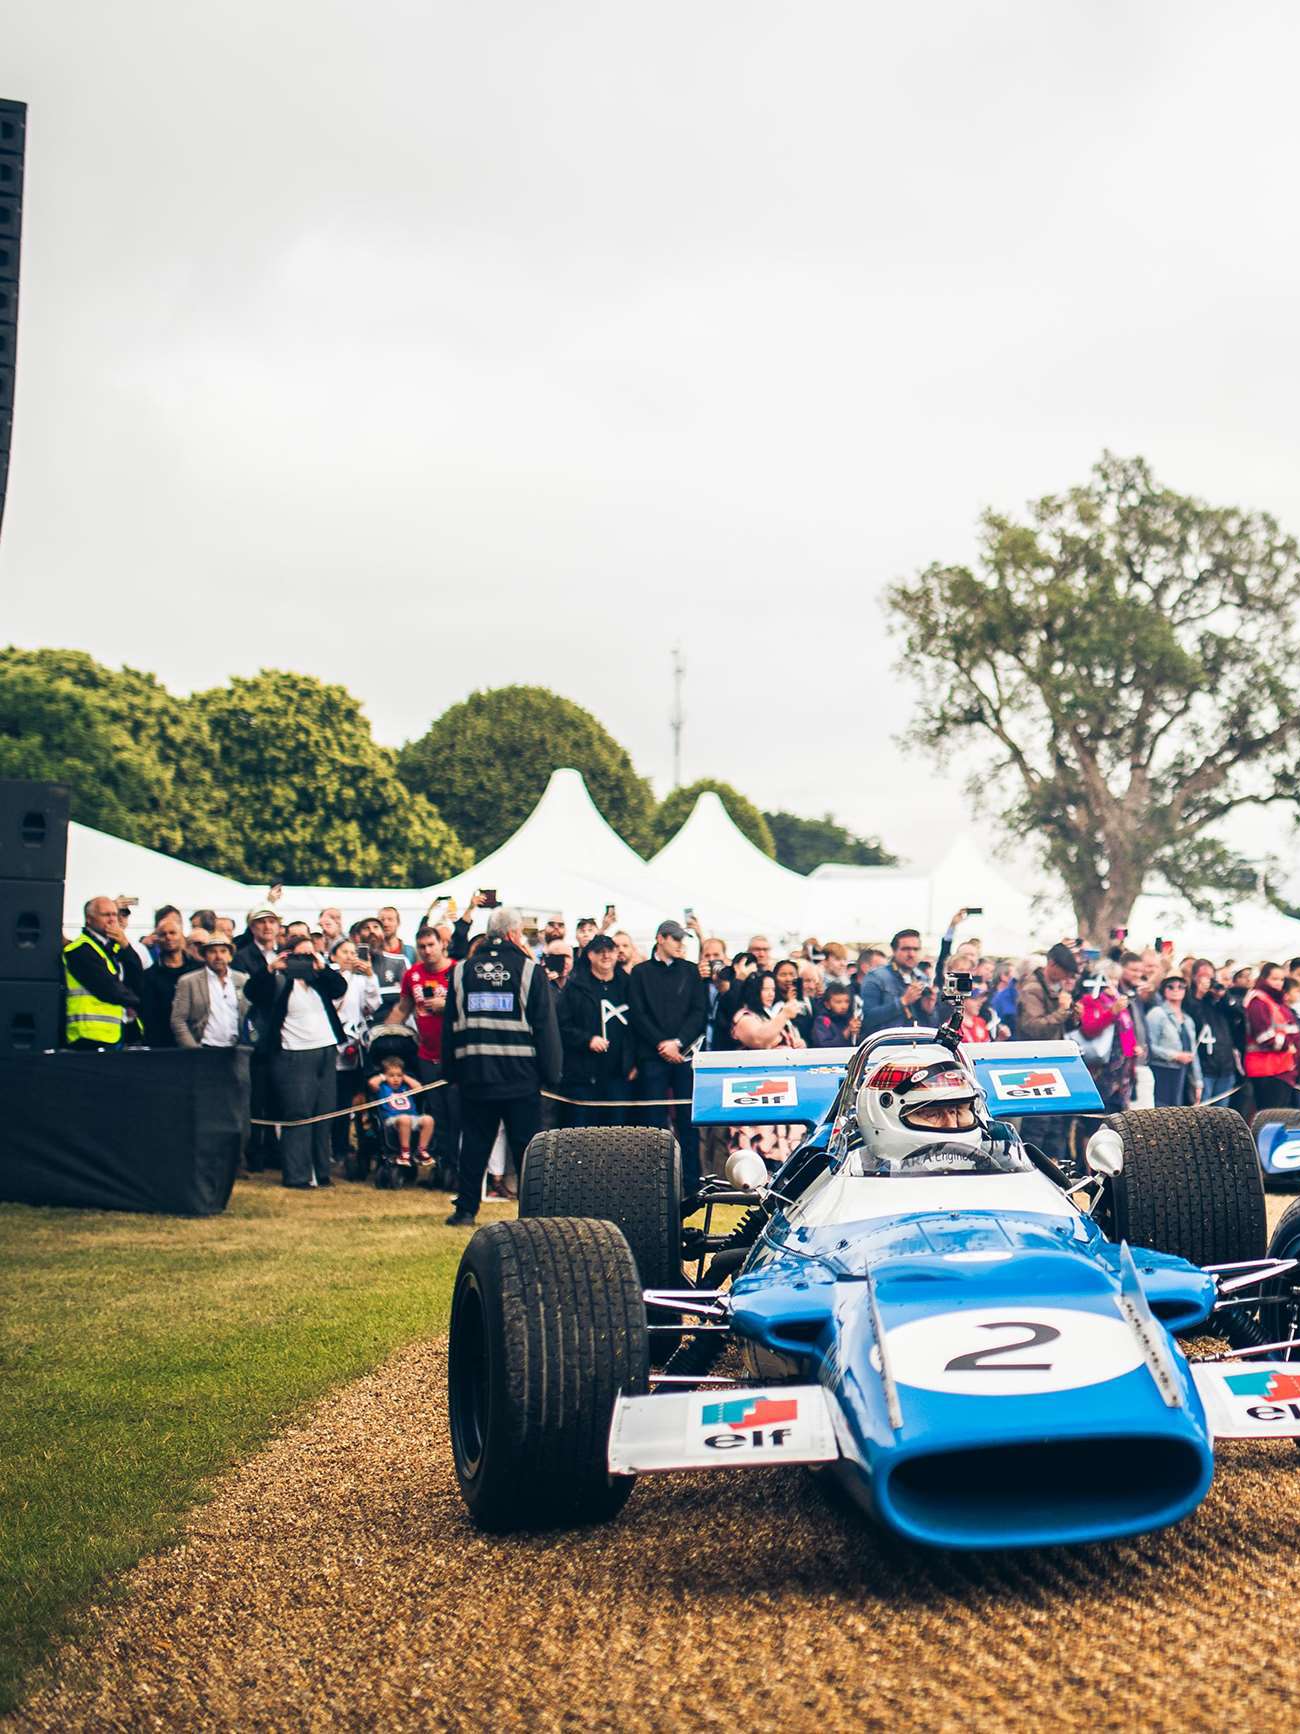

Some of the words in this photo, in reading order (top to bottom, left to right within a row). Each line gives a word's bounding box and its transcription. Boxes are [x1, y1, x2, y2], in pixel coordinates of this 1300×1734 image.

[1006, 1086, 1056, 1097] elf
[733, 1095, 785, 1105] elf
[944, 1321, 1061, 1371] 2
[704, 1428, 793, 1449] elf
